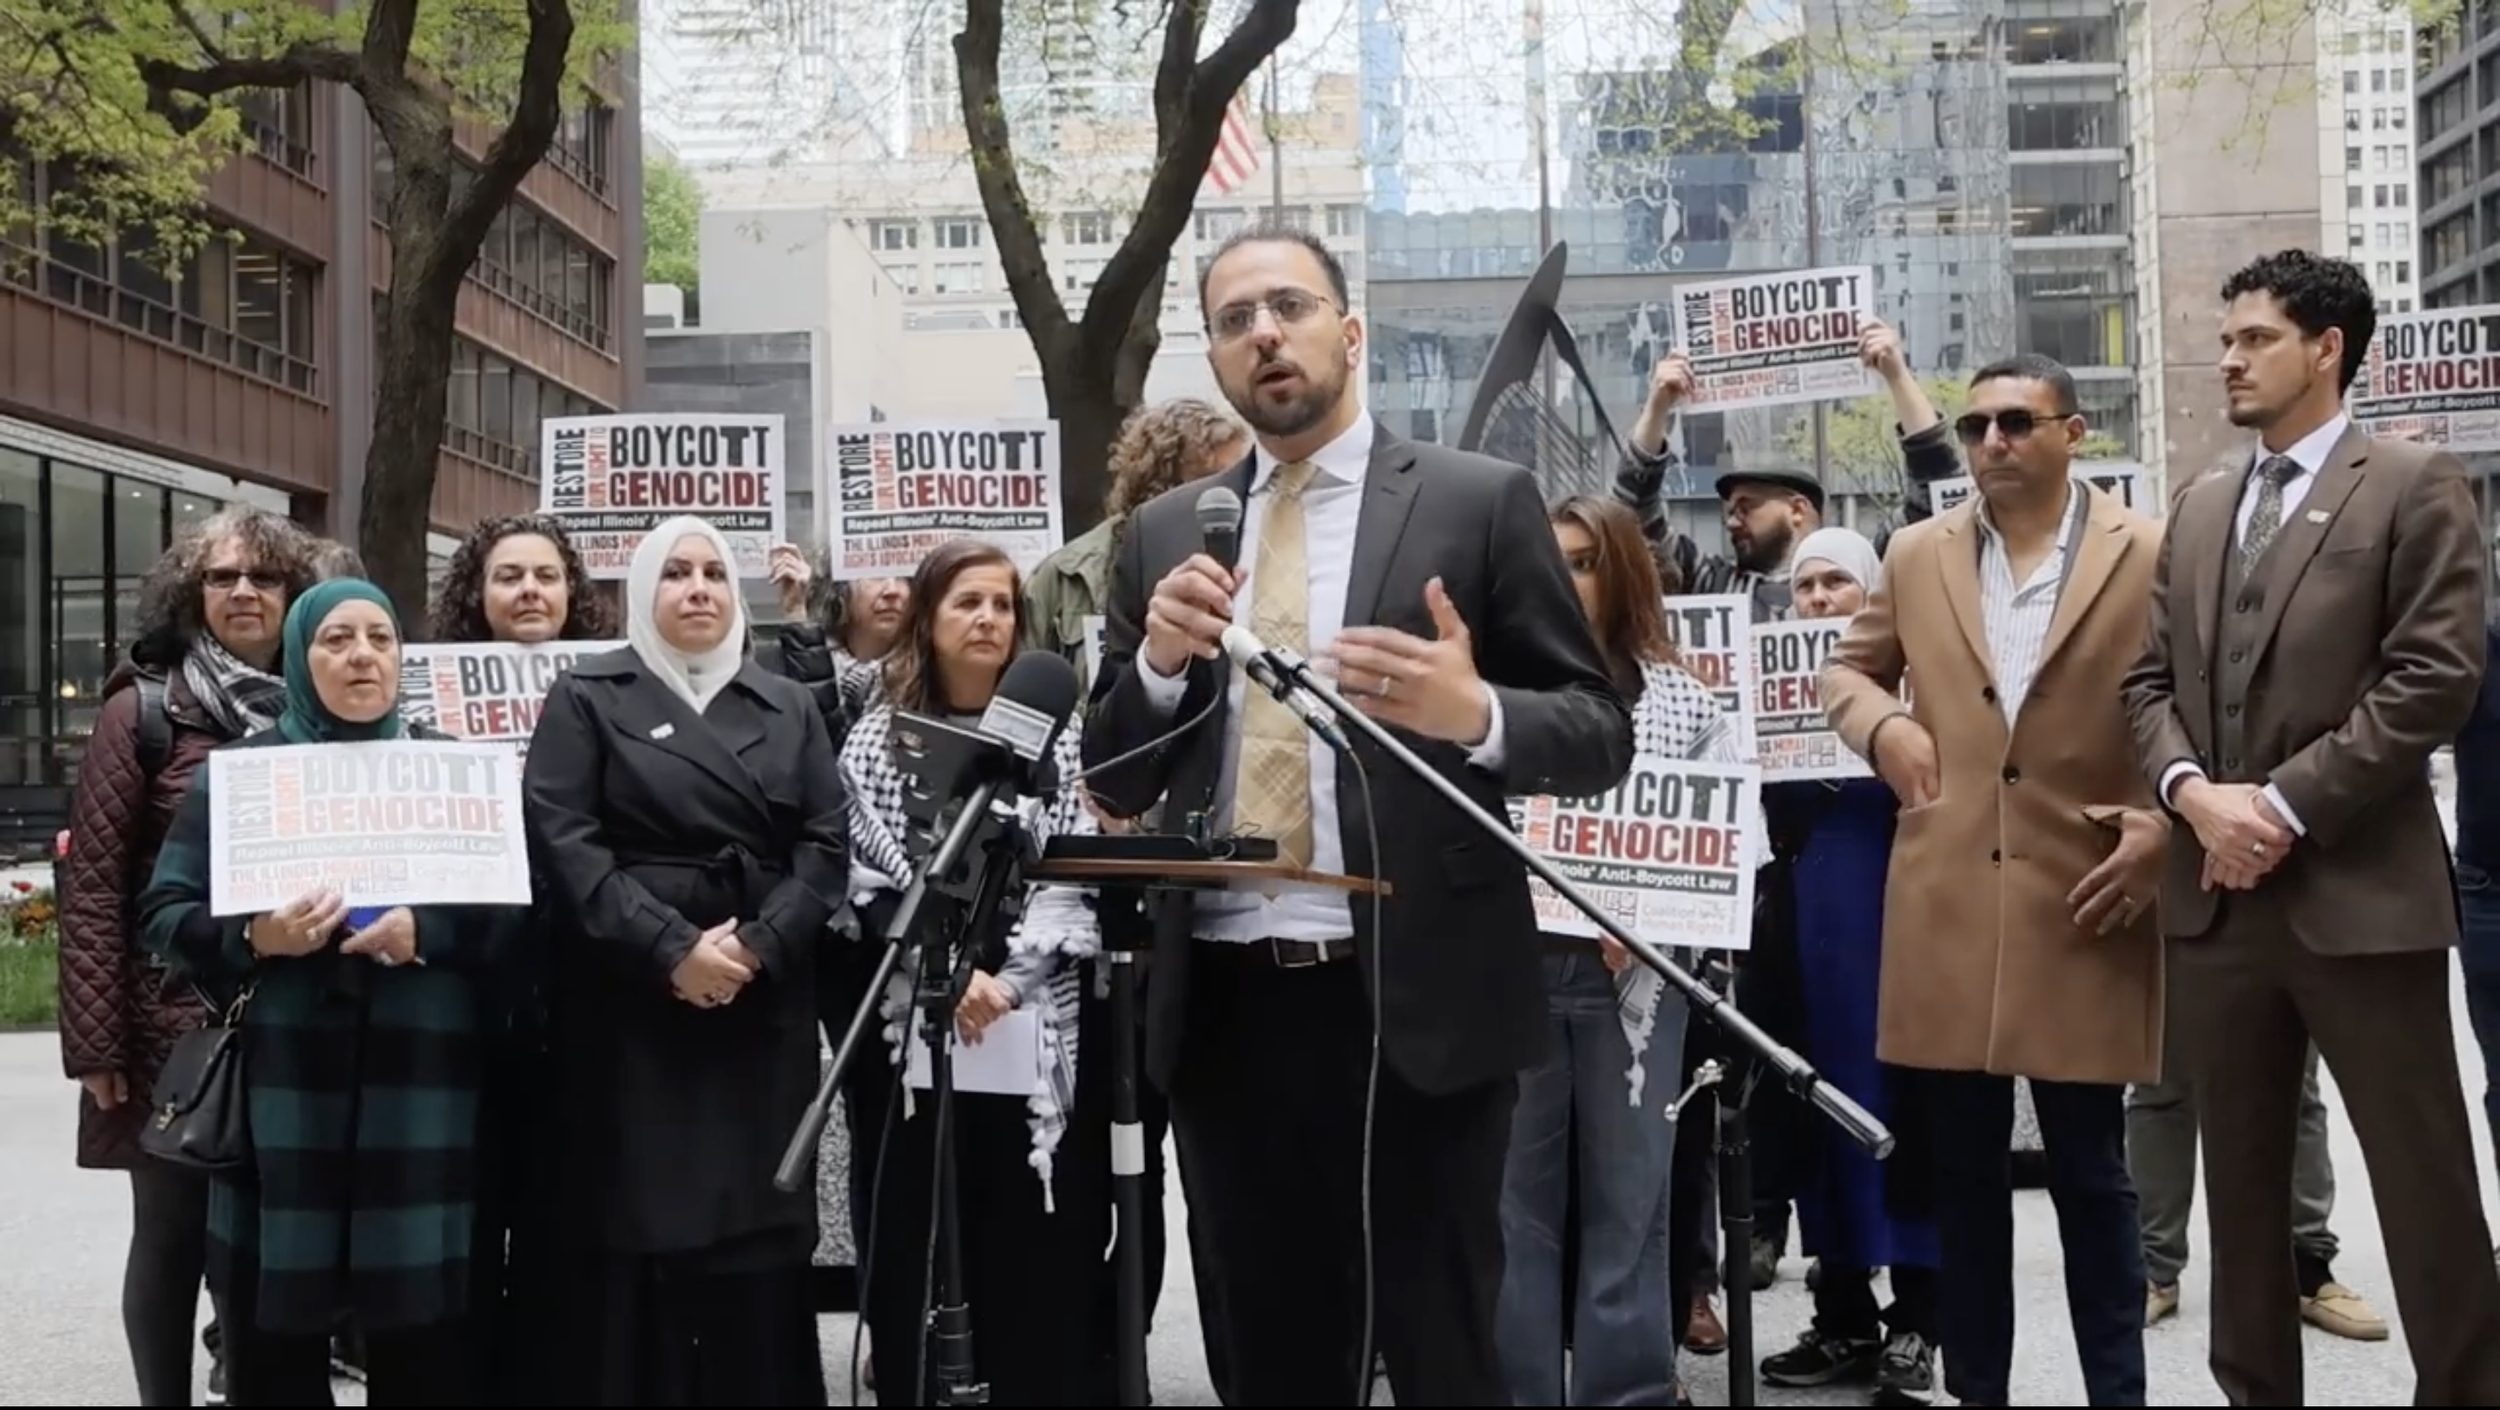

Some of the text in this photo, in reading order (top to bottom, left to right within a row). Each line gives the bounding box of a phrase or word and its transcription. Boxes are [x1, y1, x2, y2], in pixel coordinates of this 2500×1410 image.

[1732, 275, 1860, 321] BOYCOTT
[1684, 290, 1714, 357] RESTORE
[2385, 315, 2500, 361] BOYCOT
[2385, 356, 2500, 395] GENOCI
[553, 427, 585, 508] RESTORE
[610, 425, 769, 468] BOYCOTT
[895, 431, 1046, 471] BOYCOTT
[610, 471, 771, 507] GENOCIDE
[838, 432, 873, 512] RESTORE
[898, 474, 1048, 509] GENOCIDE
[739, 514, 767, 527] Law
[458, 652, 573, 697] BOYC
[1761, 630, 1841, 674] BOYC
[302, 751, 501, 796] BOYCOTT
[226, 758, 273, 840] RESTORE
[304, 796, 504, 834] GENOCIDE
[1557, 771, 1744, 824] YCOTT
[1553, 814, 1741, 868] GENOCIDE
[1598, 866, 1697, 888] Anti-Boycott
[1699, 875, 1732, 890] Law
